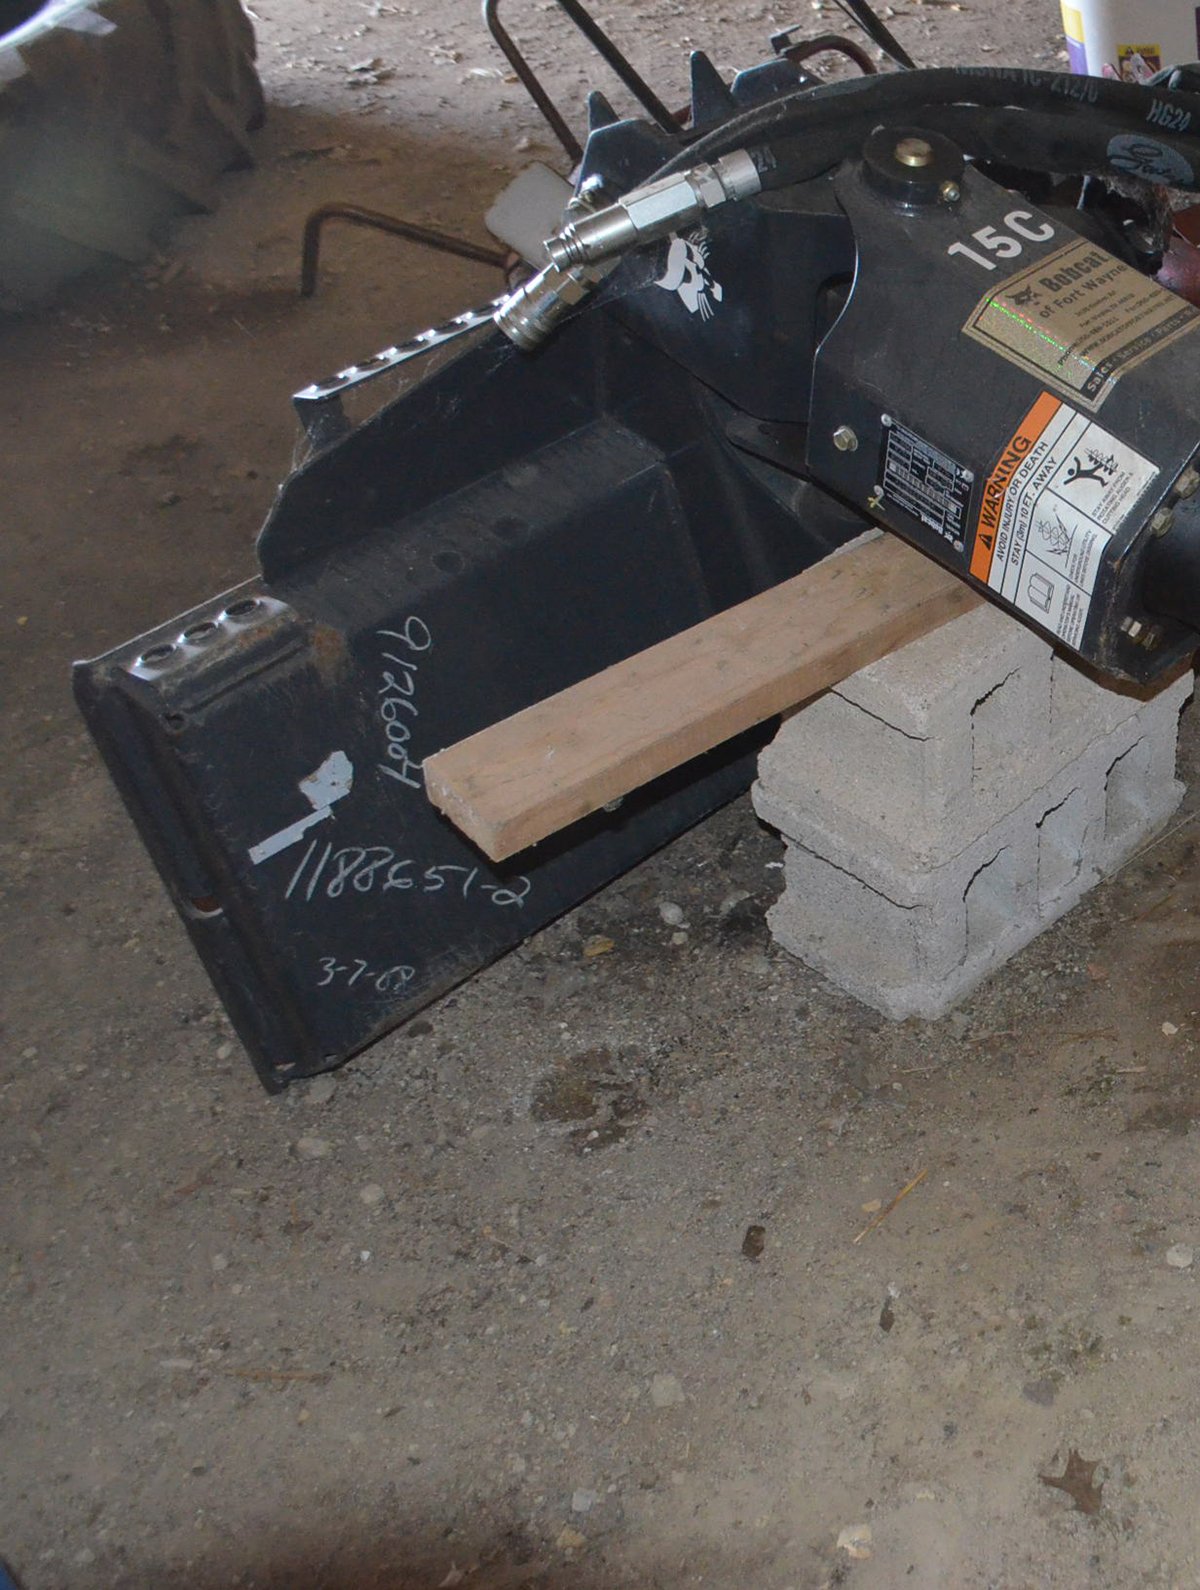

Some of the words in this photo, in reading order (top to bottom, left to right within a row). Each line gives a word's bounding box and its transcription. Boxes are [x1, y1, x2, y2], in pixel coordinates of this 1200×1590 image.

[948, 210, 1055, 271] 15C
[1039, 251, 1110, 293] Bobcat
[1039, 299, 1057, 318] of
[1056, 284, 1085, 309] Fort
[1084, 263, 1128, 293] Wayne
[1086, 360, 1114, 393] Sales
[1017, 440, 1048, 478] DEATH
[1032, 455, 1056, 490] AWAY
[981, 434, 1032, 524] WARNING
[1008, 477, 1022, 496] OR
[1002, 495, 1015, 532] INJURY
[1018, 505, 1029, 519] 10
[997, 530, 1008, 562] AVOID
[1017, 519, 1028, 542] (3m)
[1011, 539, 1023, 565] STAY
[376, 615, 432, 790] 9126004
